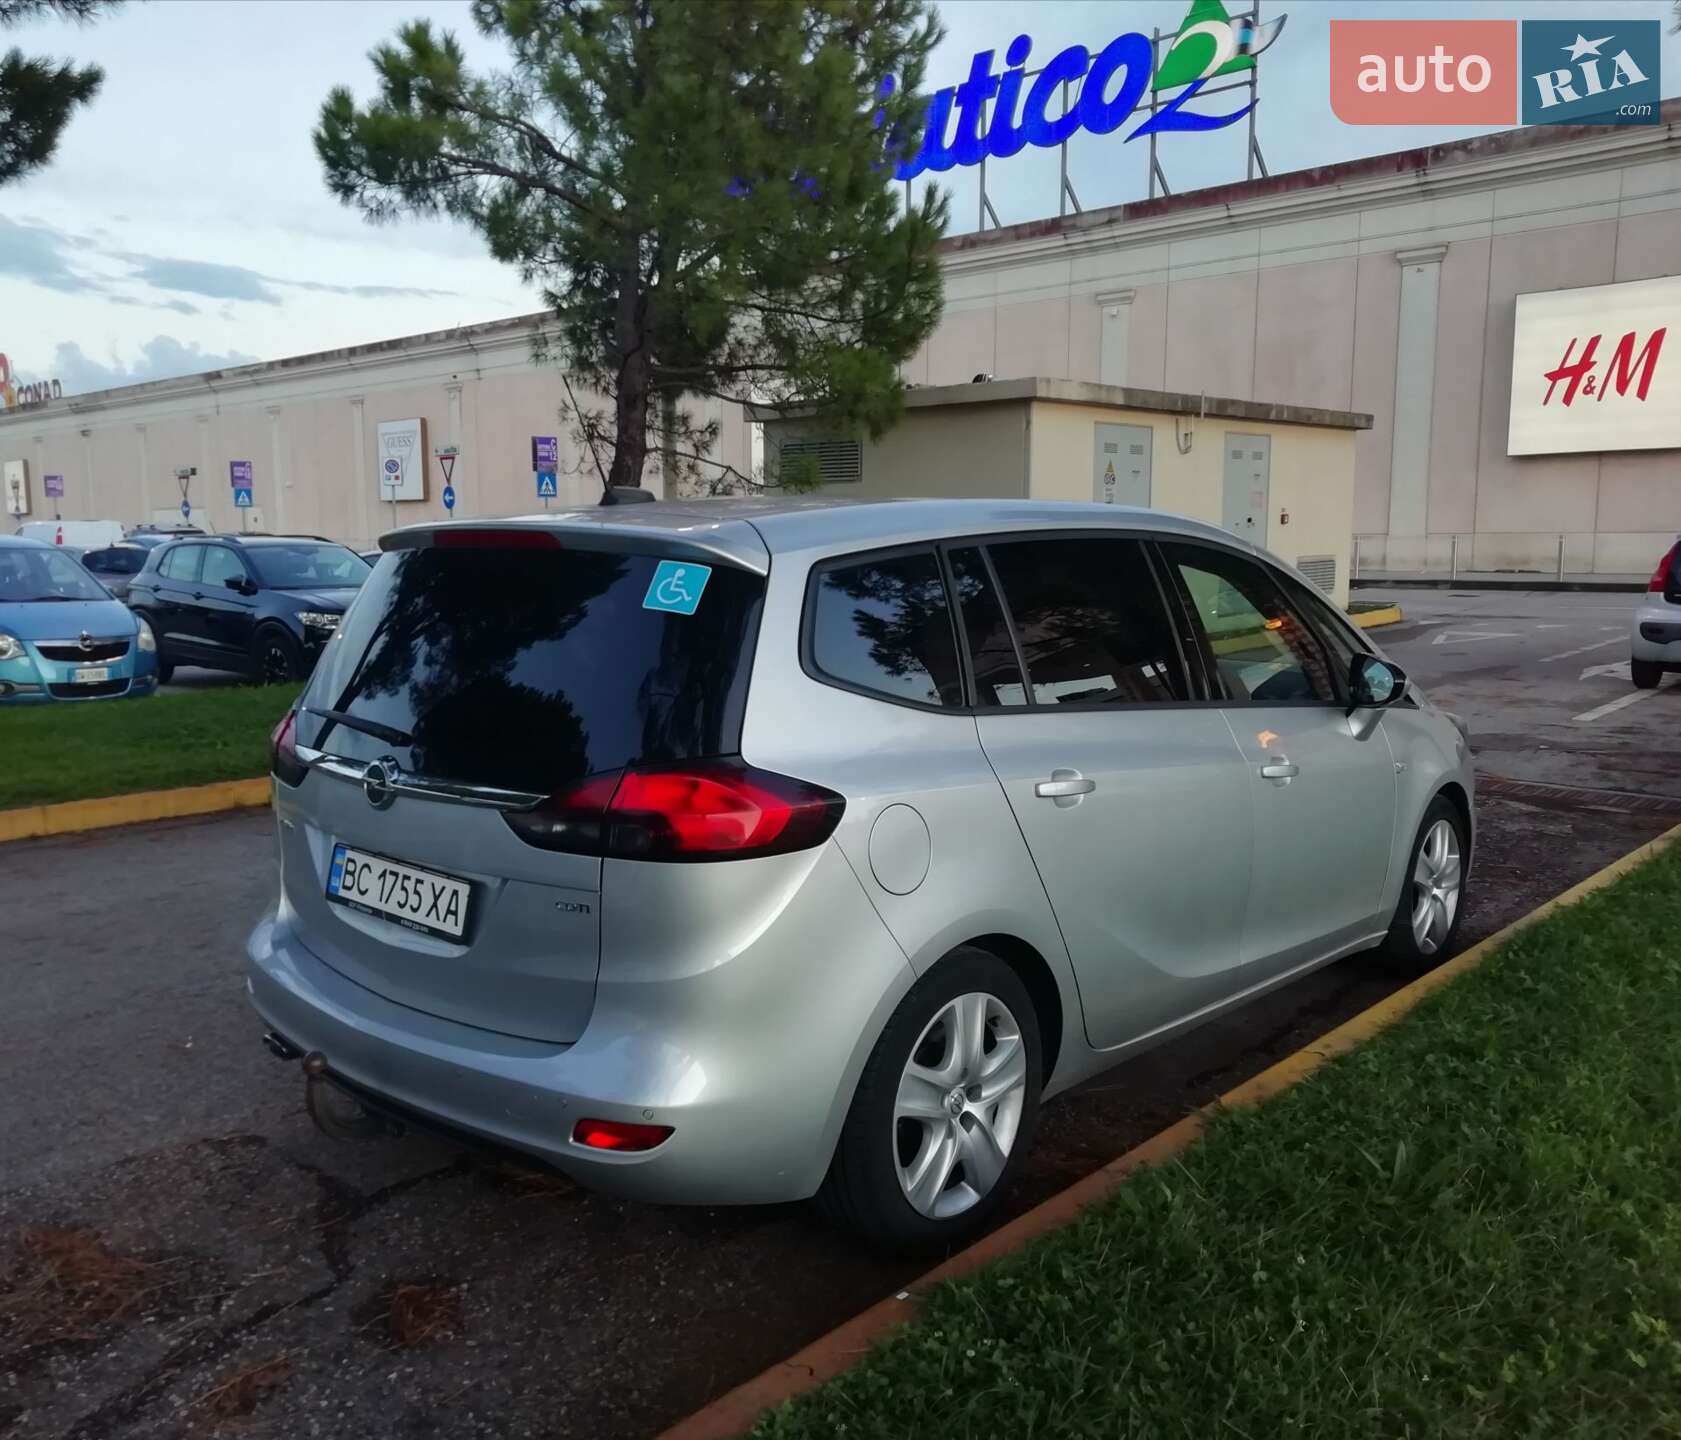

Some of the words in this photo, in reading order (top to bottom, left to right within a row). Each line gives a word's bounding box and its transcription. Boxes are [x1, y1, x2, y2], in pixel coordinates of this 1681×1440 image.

[16, 379, 62, 409] CONAD
[1542, 327, 1667, 408] H&M
[341, 857, 372, 896] BC
[377, 868, 425, 914] 1755
[425, 882, 460, 928] XA
